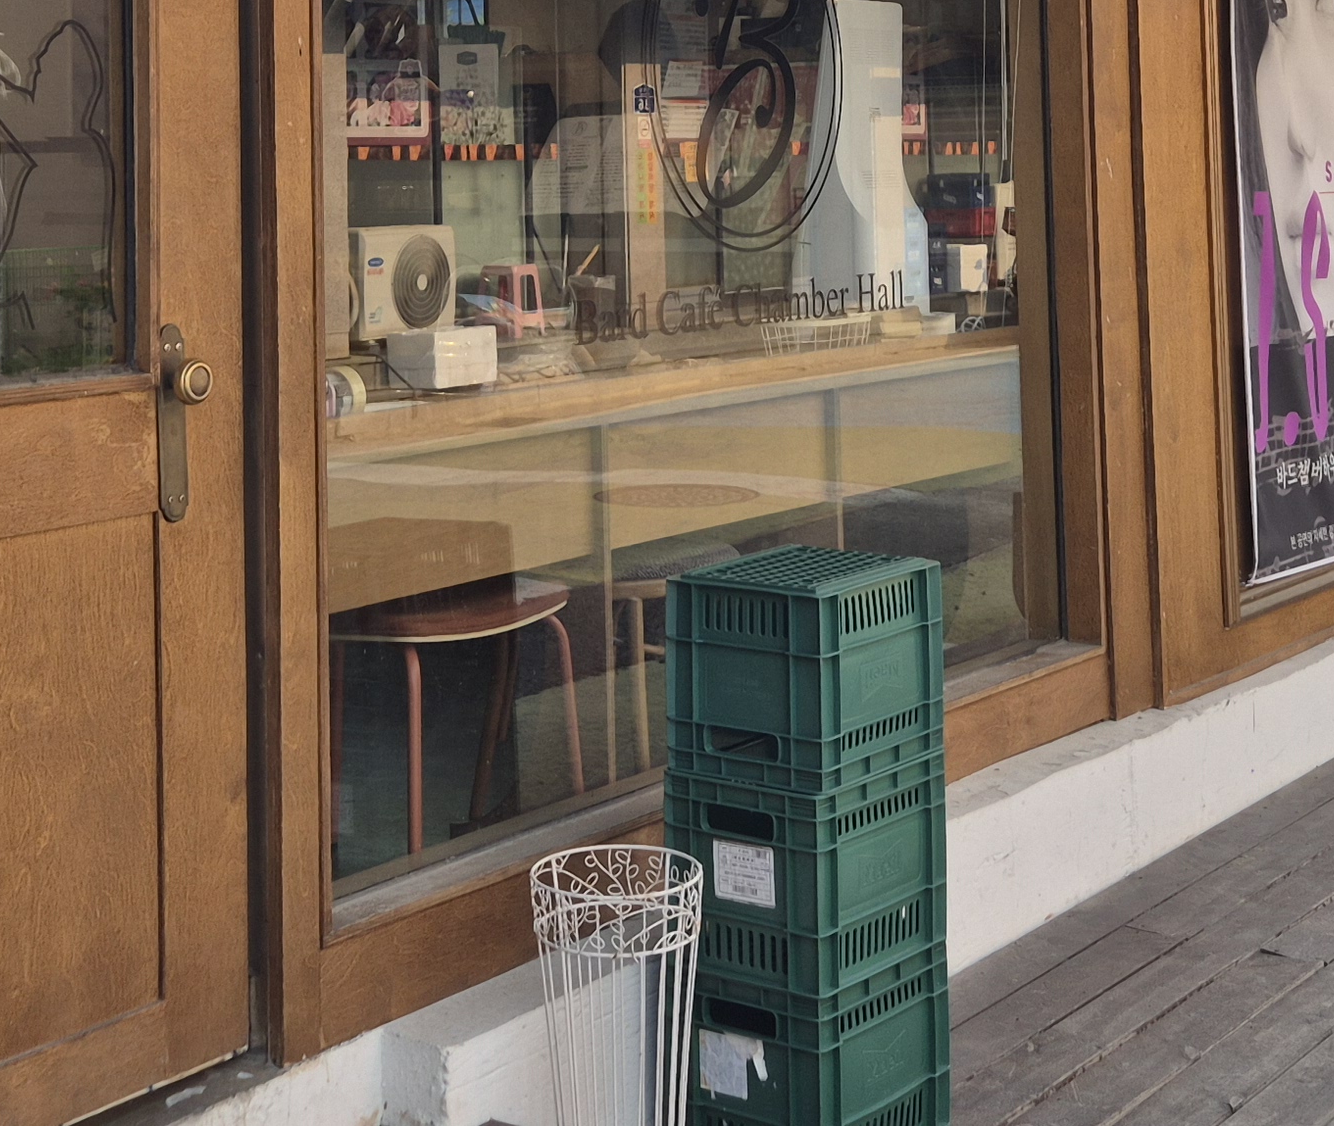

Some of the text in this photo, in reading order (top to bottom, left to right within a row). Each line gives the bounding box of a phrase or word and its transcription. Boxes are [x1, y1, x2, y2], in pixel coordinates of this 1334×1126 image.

[574, 292, 649, 346] Bard
[731, 276, 850, 328] Chamber
[856, 269, 907, 314] Hall
